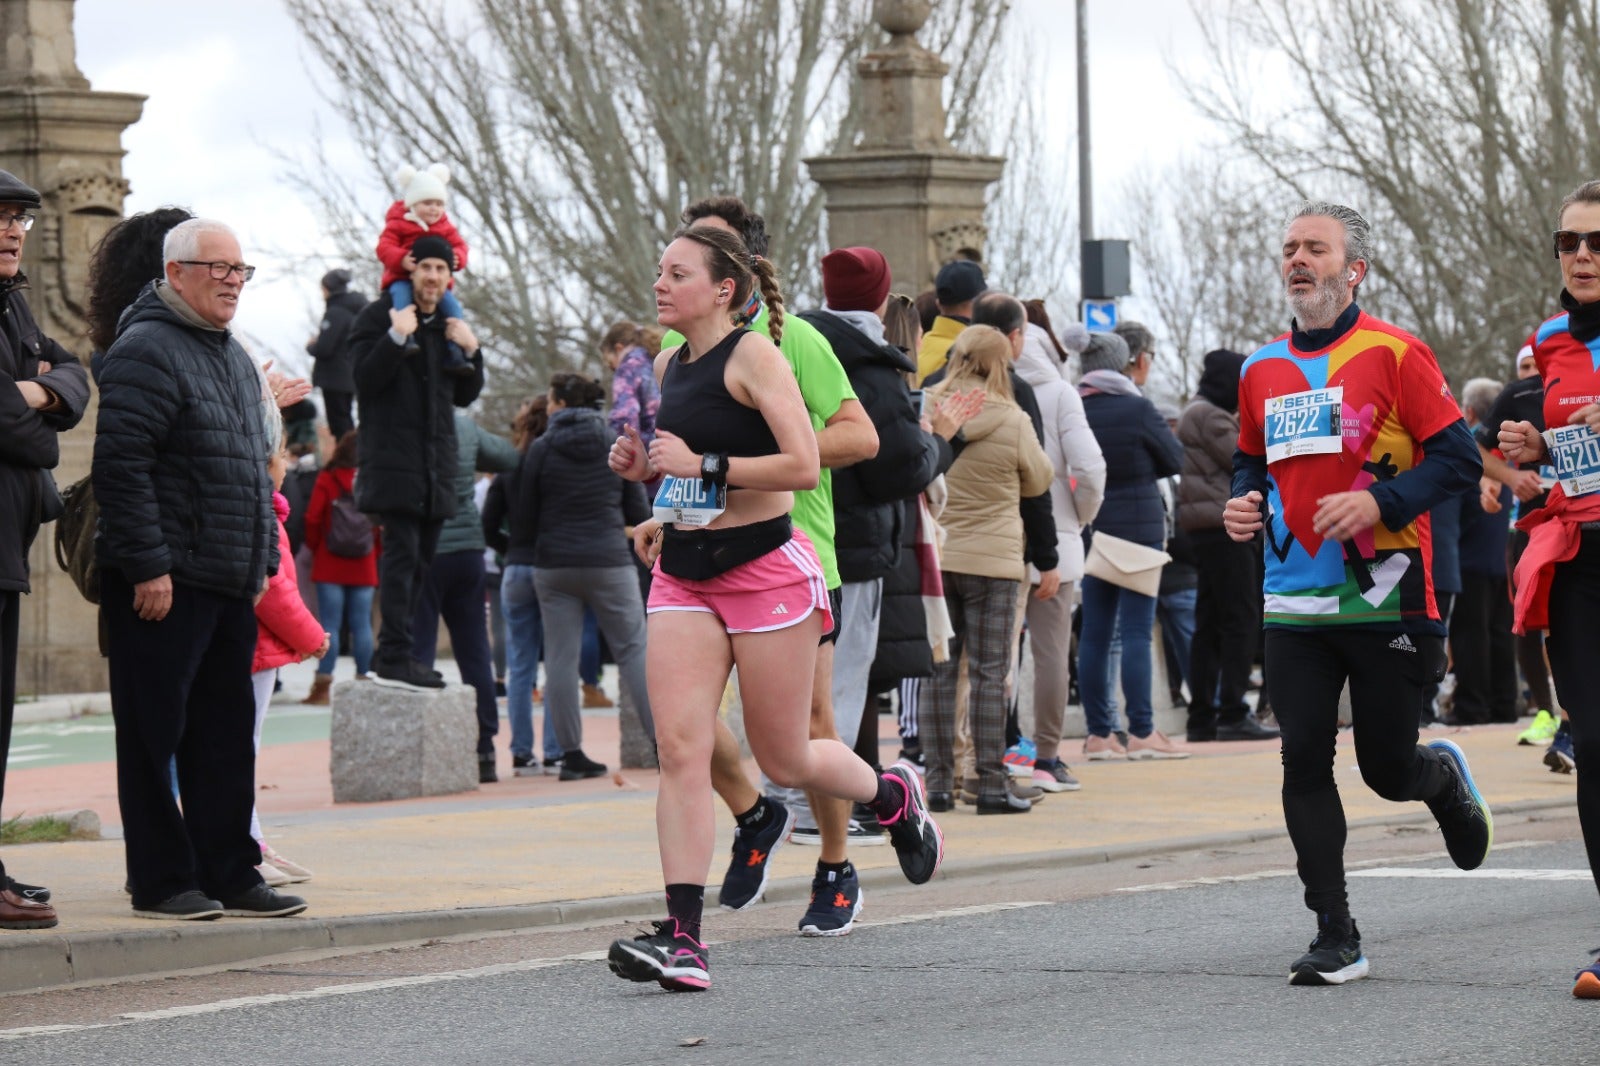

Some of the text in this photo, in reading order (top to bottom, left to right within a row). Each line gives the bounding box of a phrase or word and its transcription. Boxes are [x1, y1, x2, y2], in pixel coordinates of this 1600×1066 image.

[1284, 392, 1333, 409] SETEL
[1273, 406, 1320, 439] 2622
[1555, 426, 1597, 443] SETE
[1553, 440, 1600, 474] 2620
